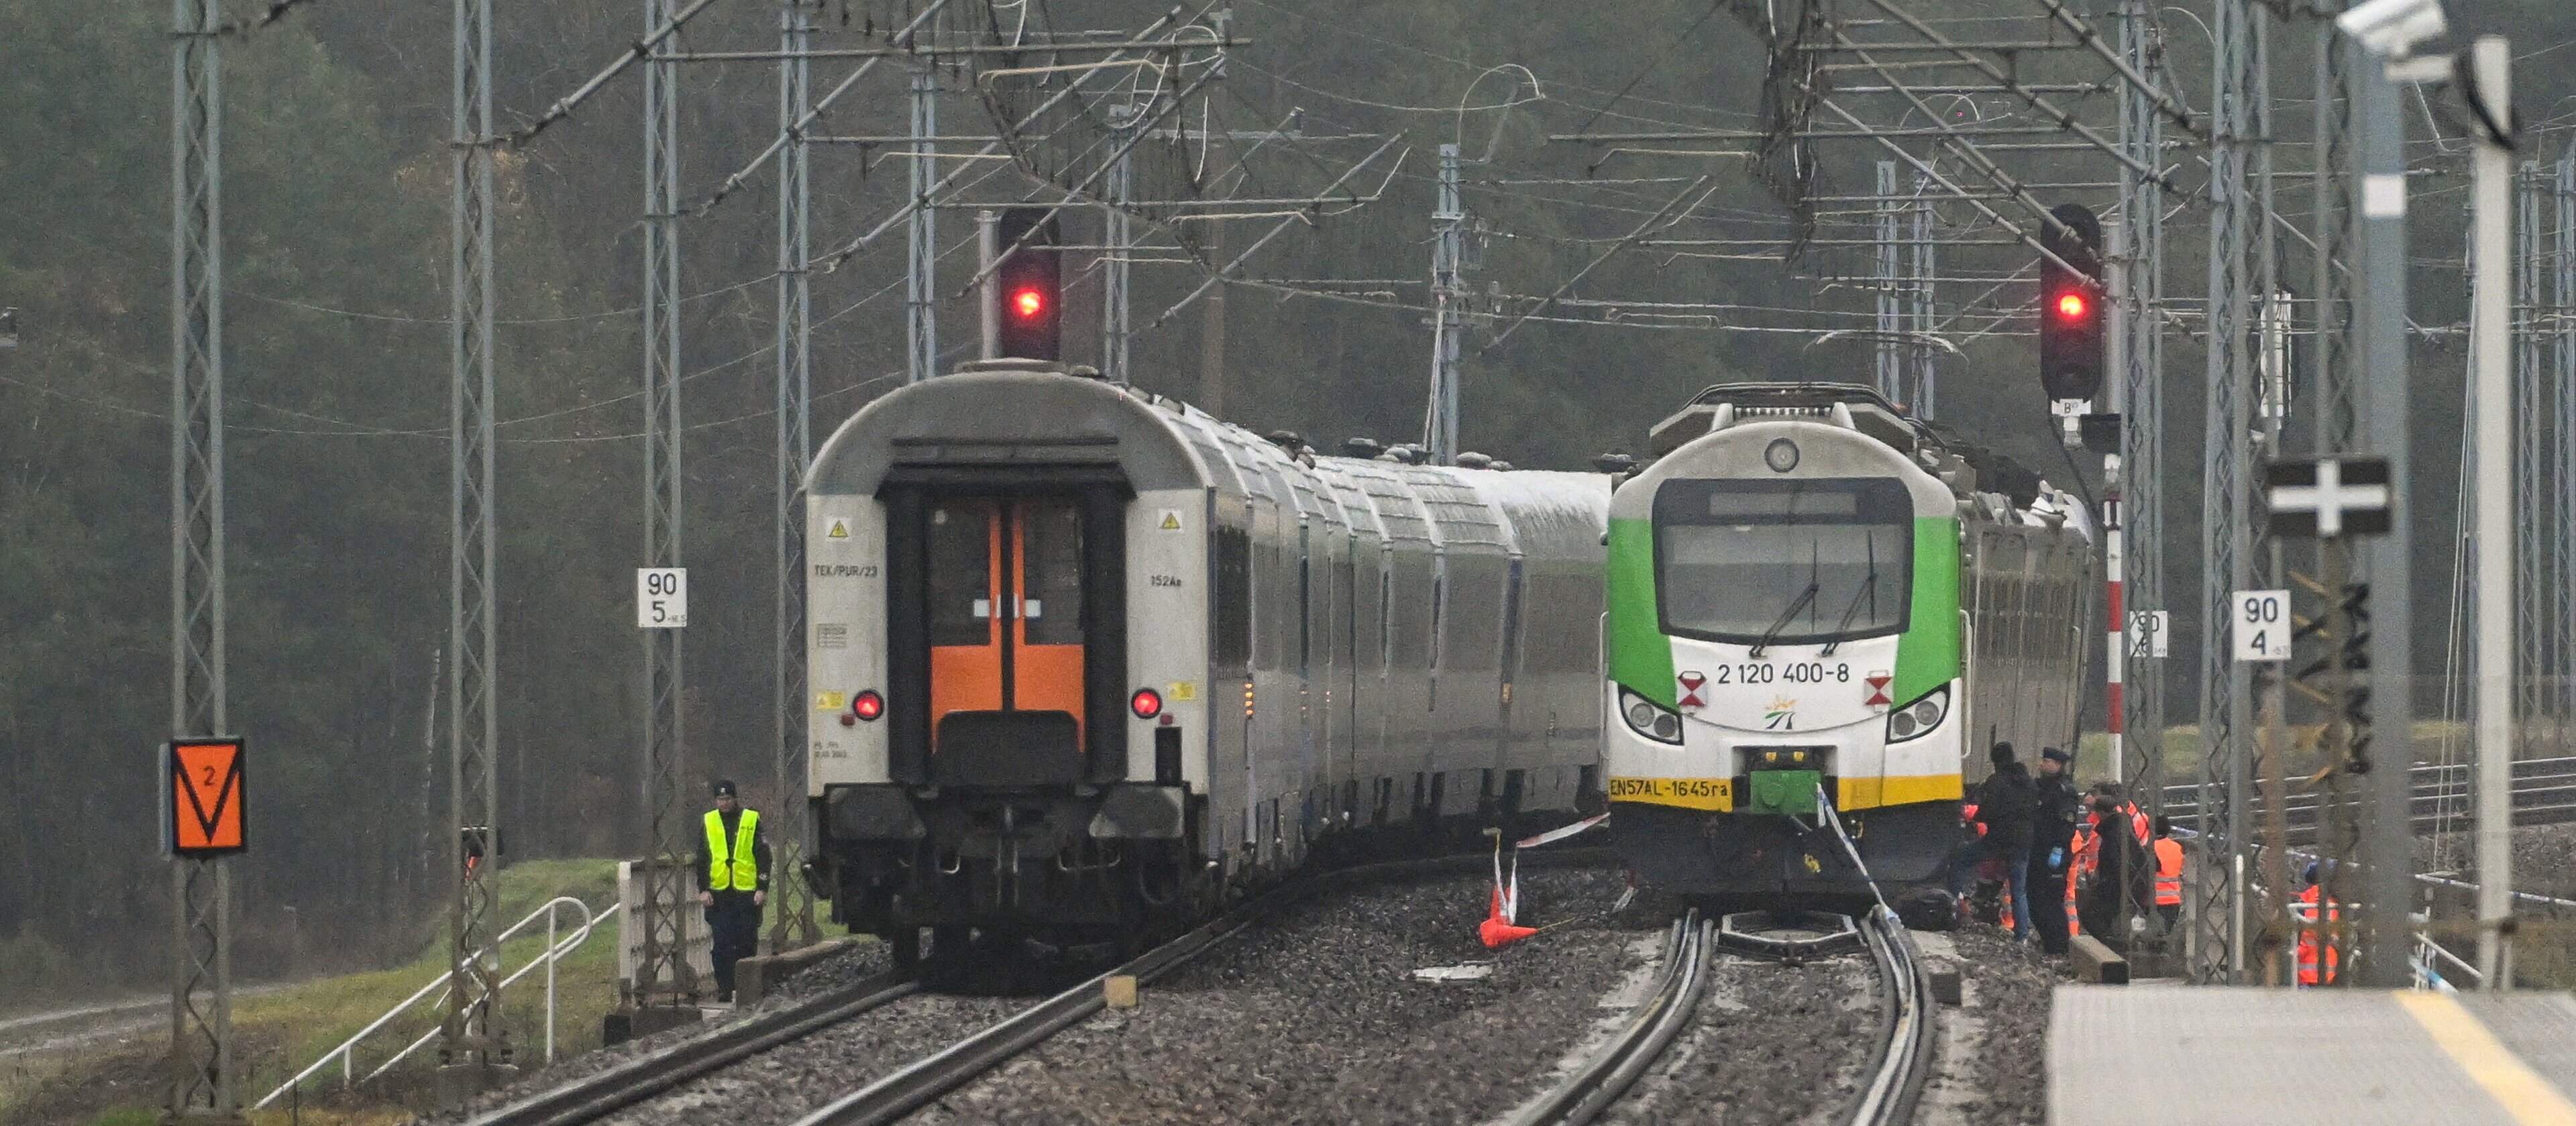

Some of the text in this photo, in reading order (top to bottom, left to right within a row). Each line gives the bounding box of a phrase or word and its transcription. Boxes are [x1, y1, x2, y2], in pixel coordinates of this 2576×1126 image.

[648, 572, 677, 596] 90
[652, 600, 666, 624] 5
[2245, 597, 2278, 624] 90
[2251, 630, 2266, 655] 4
[1718, 663, 1849, 684] 2 120 400-8
[203, 765, 215, 787] 2
